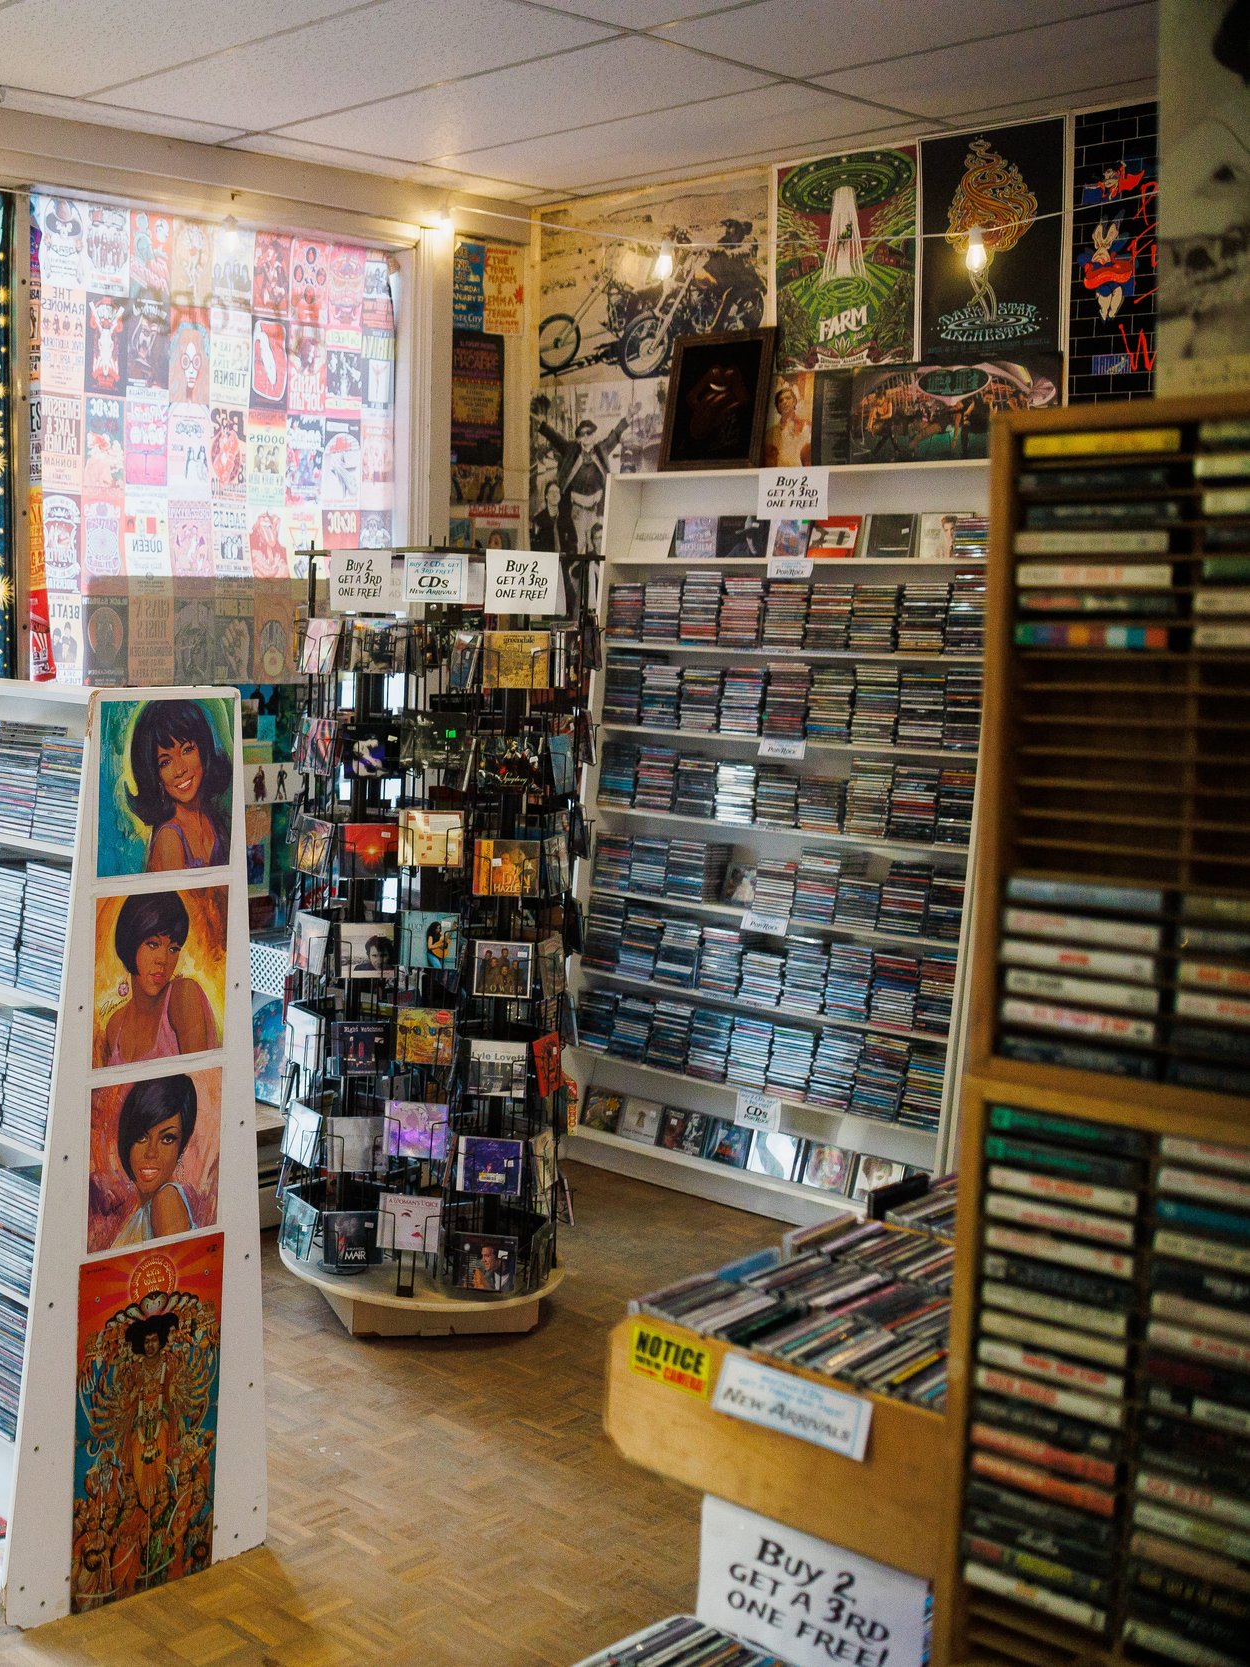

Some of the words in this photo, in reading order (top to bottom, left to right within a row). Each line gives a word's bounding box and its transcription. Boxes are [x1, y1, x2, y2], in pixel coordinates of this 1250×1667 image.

[819, 306, 868, 342] FARM
[767, 489, 785, 498] GET
[787, 489, 796, 497] A
[798, 486, 819, 498] 3RD
[766, 499, 785, 508] ONE
[789, 497, 819, 508] FREE!
[338, 575, 355, 585] GET
[355, 575, 362, 583] A
[363, 572, 382, 585] 3RD
[496, 576, 516, 586] GET
[518, 576, 527, 586] A
[528, 574, 548, 587] 3RD
[338, 587, 355, 597] ONE
[356, 586, 382, 598] FREE!
[496, 588, 517, 599] ONE
[519, 588, 548, 600] FREE!
[503, 636, 536, 645] greendale
[482, 983, 524, 994] POWER
[494, 1052, 526, 1062] Lovett
[344, 1250, 366, 1260] MAIR
[635, 1330, 705, 1376] NOTICE
[729, 1563, 785, 1597] GET
[790, 1592, 811, 1615] A
[823, 1596, 891, 1645] 3RD
[727, 1589, 786, 1630] ONE
[796, 1620, 890, 1667] FREE!
